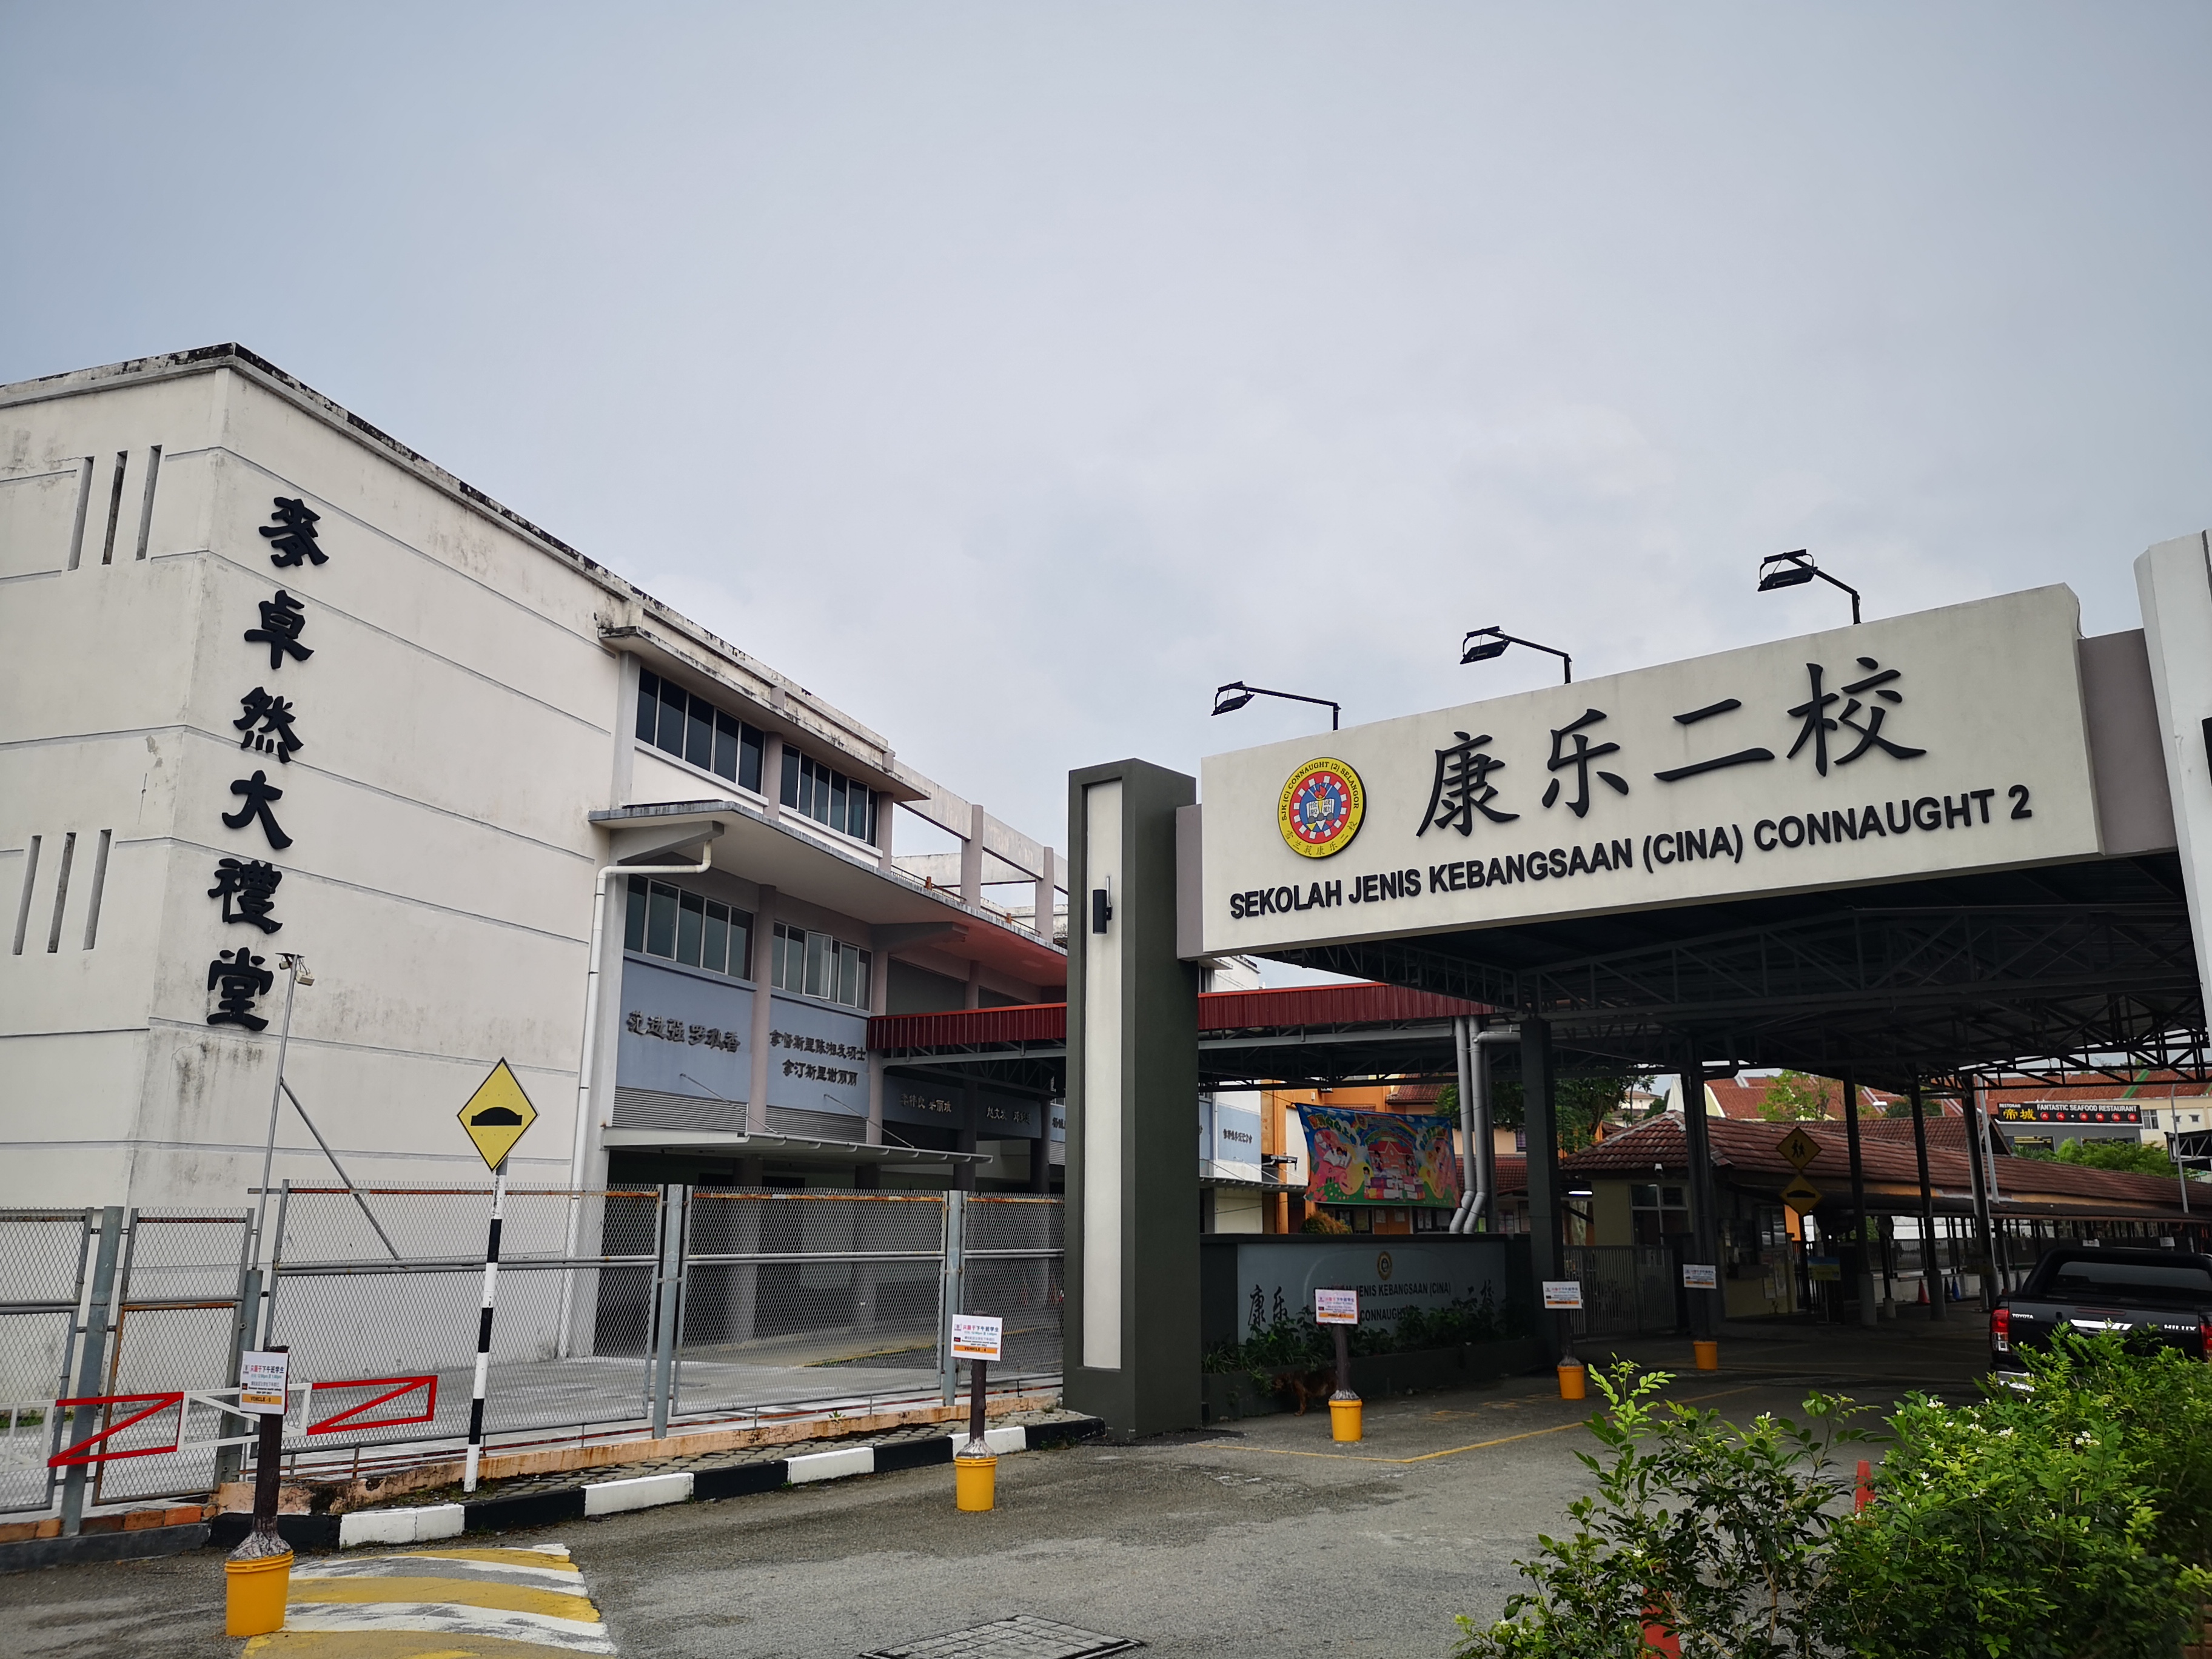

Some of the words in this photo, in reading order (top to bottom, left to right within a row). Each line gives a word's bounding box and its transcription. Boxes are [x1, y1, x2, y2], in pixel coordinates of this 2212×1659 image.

[1416, 656, 1926, 837] 康乐二校
[1289, 762, 1330, 789] CONNAUGHT
[1330, 762, 1340, 772] (2)
[1340, 768, 1359, 809] SELANGOR
[1230, 879, 1341, 919] SEKOLAH
[1349, 869, 1421, 904] JENIS
[1429, 838, 1633, 893] KEBANGSAAN
[1643, 824, 1743, 873] (CINA)
[1754, 788, 1995, 851] CONNAUGHT
[2008, 785, 2033, 820] 2
[2003, 1108, 2036, 1121] 帝城
[1379, 1283, 1427, 1296] KEBANGSAAN
[1430, 1282, 1451, 1296] (CINA)
[1360, 1307, 1404, 1321] CONNAUGH
